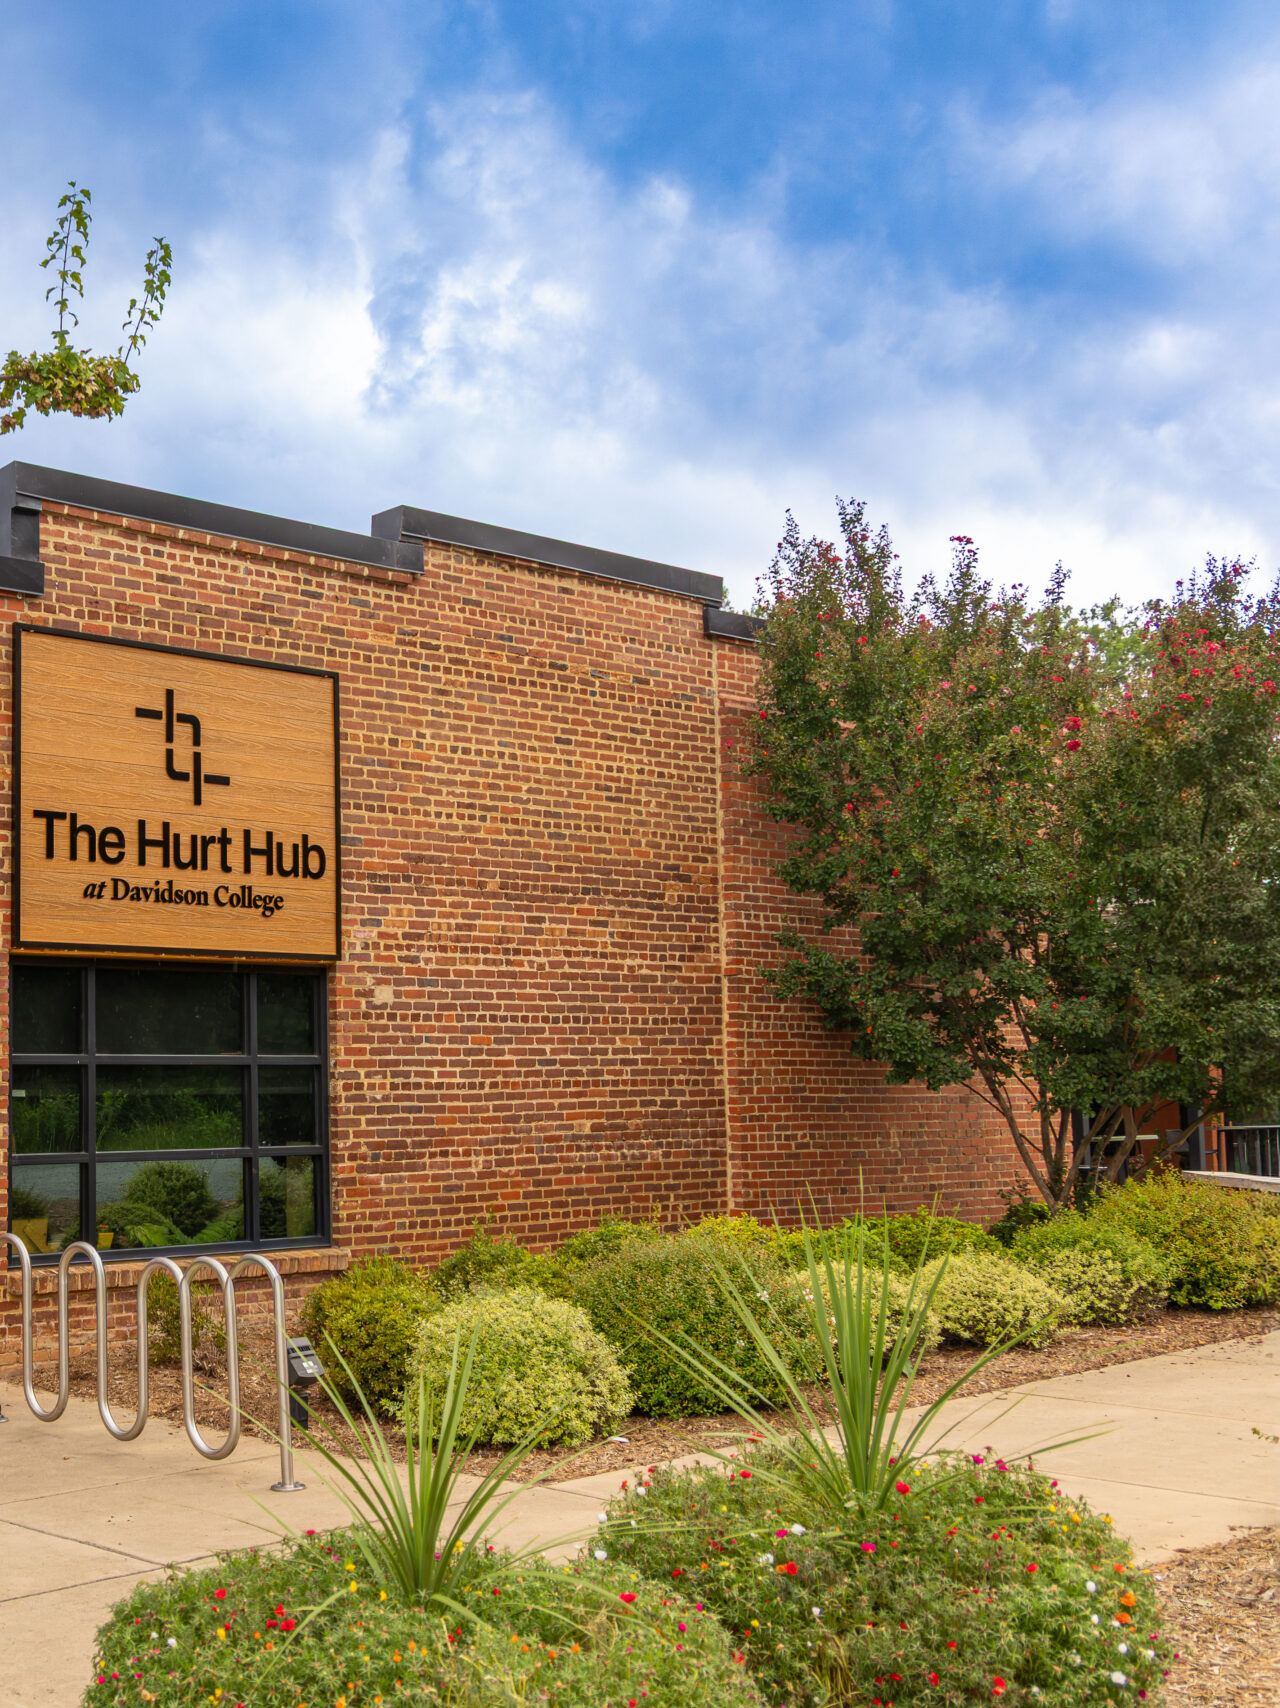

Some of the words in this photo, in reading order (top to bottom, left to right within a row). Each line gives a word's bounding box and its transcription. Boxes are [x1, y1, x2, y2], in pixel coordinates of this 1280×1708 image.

[33, 809, 126, 865] The
[137, 819, 233, 873] Hurt
[242, 828, 326, 880] Hub
[83, 880, 107, 899] at
[110, 878, 209, 906] Davidson
[213, 885, 284, 917] College
